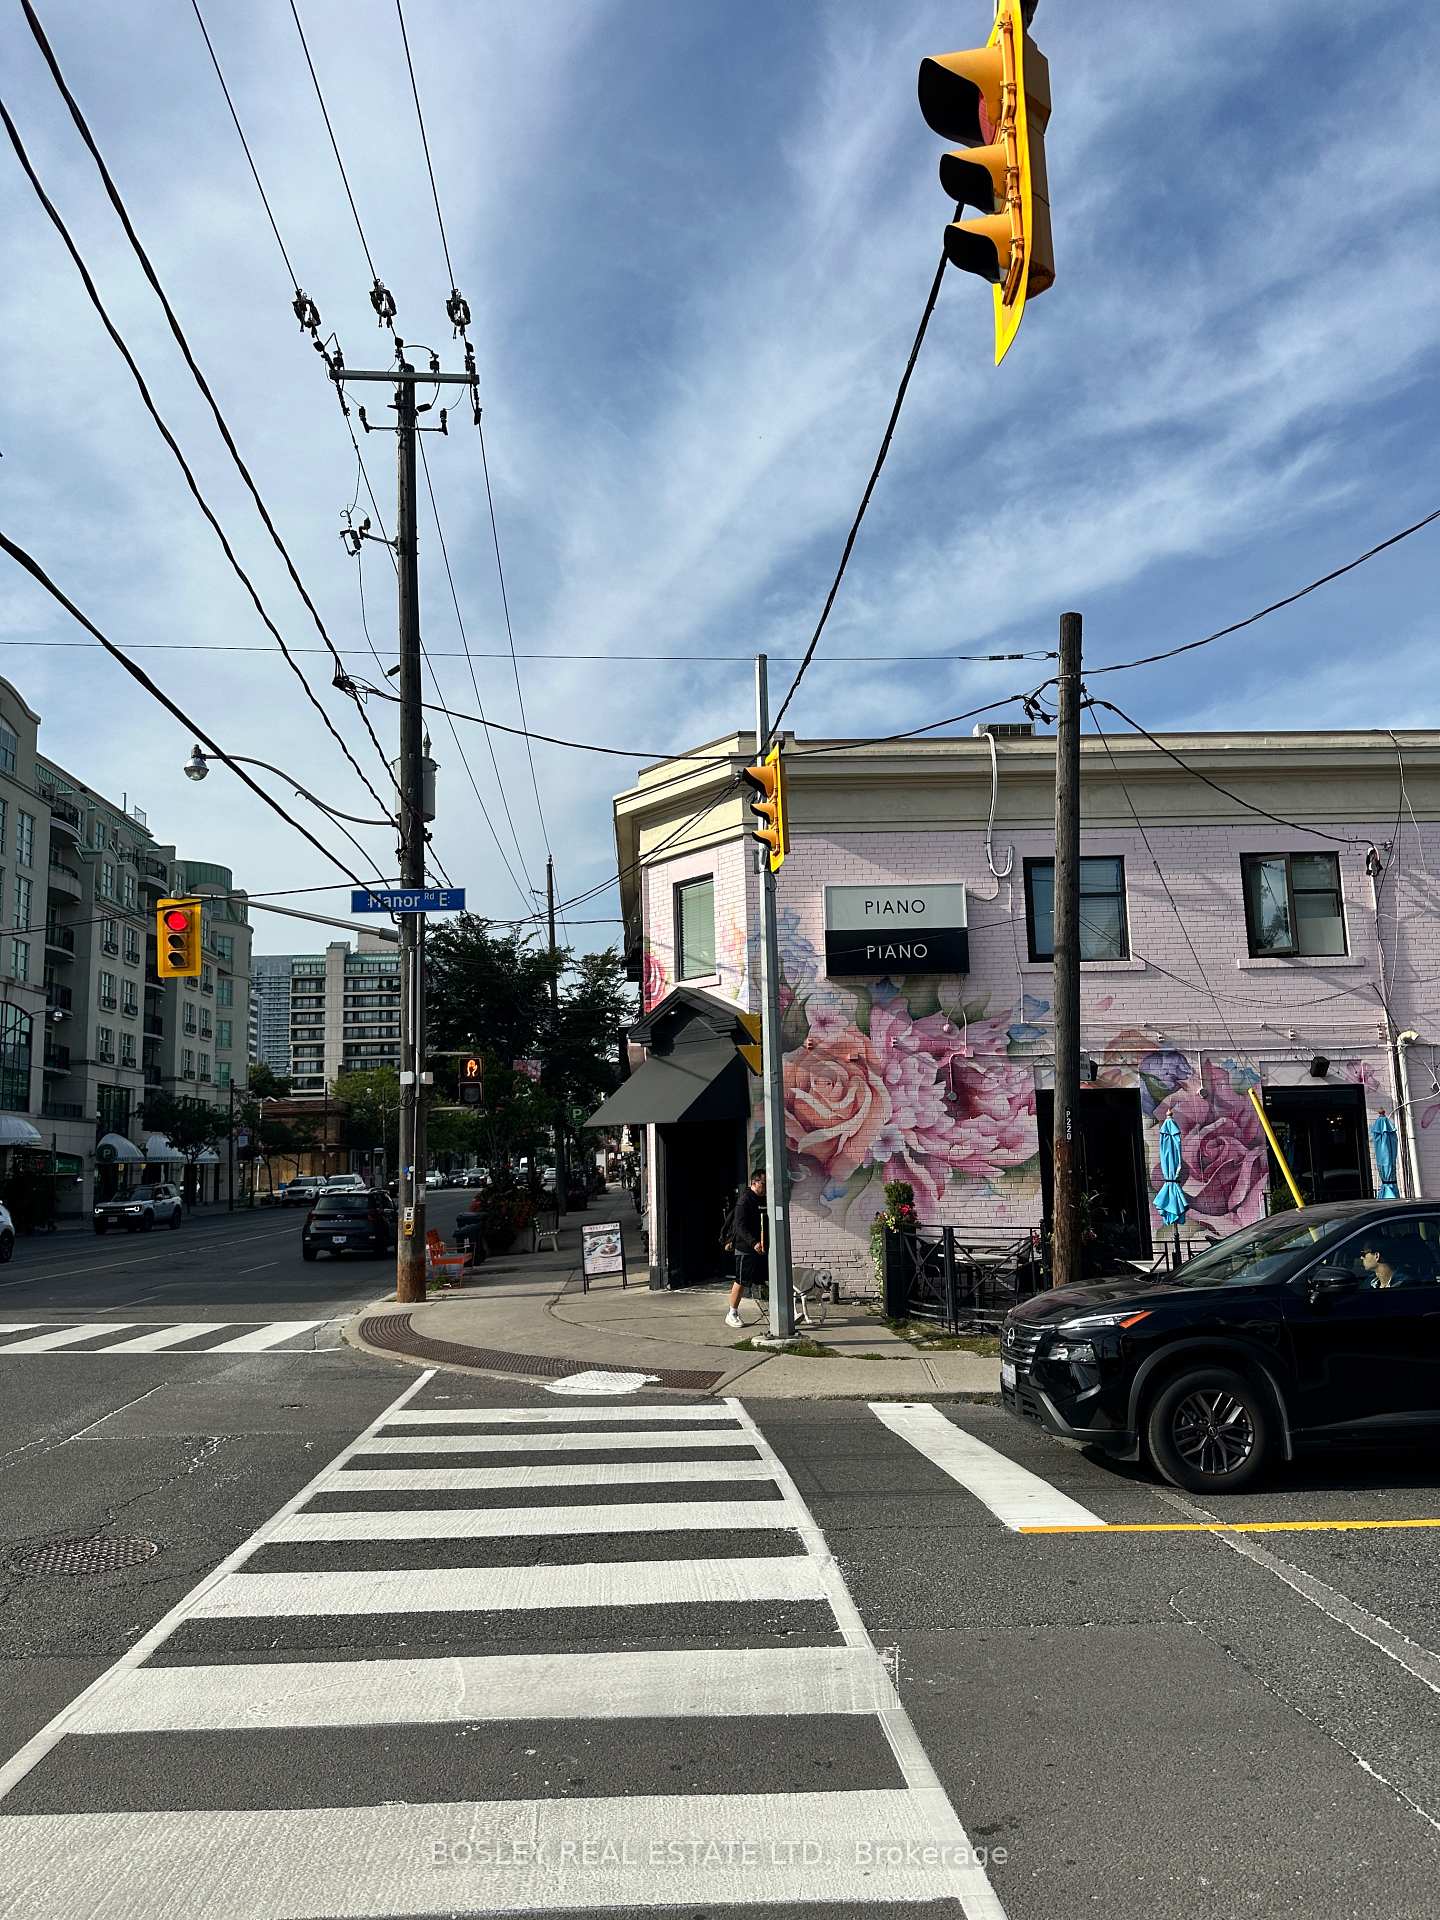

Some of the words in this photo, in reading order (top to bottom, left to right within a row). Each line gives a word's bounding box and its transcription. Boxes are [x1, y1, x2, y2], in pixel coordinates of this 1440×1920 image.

[369, 894, 421, 909] Manor
[424, 892, 435, 901] Rd
[439, 892, 448, 907] E
[865, 899, 926, 914] PIANO
[866, 943, 928, 959] PIANO
[572, 1108, 583, 1119] P
